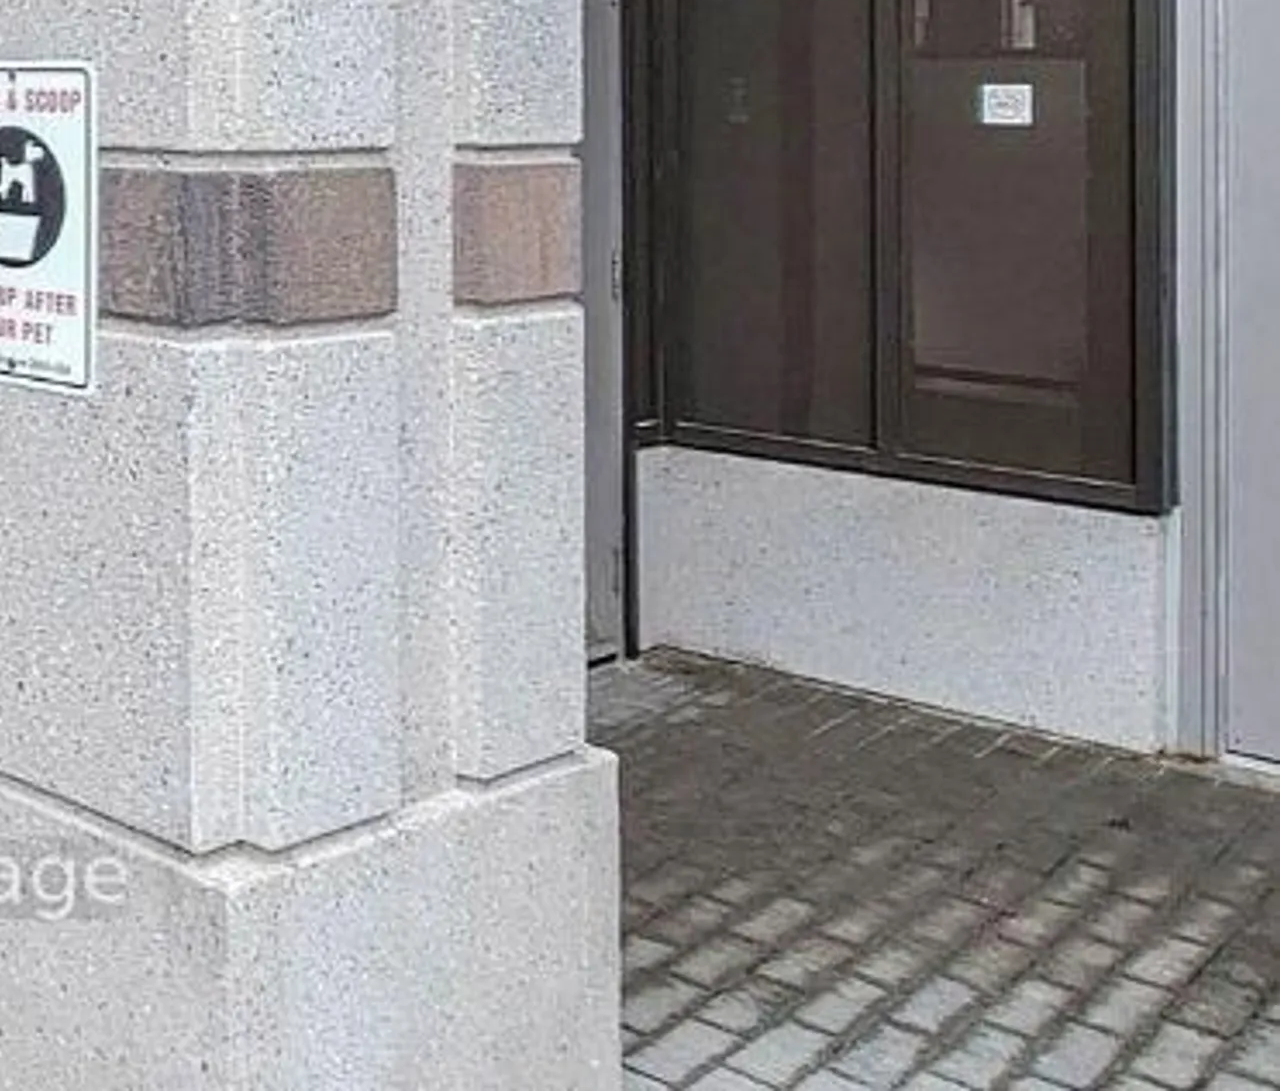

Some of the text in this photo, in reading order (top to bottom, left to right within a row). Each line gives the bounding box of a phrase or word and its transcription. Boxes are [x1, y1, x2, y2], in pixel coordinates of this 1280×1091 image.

[24, 87, 82, 114] SCOOP
[23, 289, 79, 316] AFTER
[21, 320, 54, 345] PET
